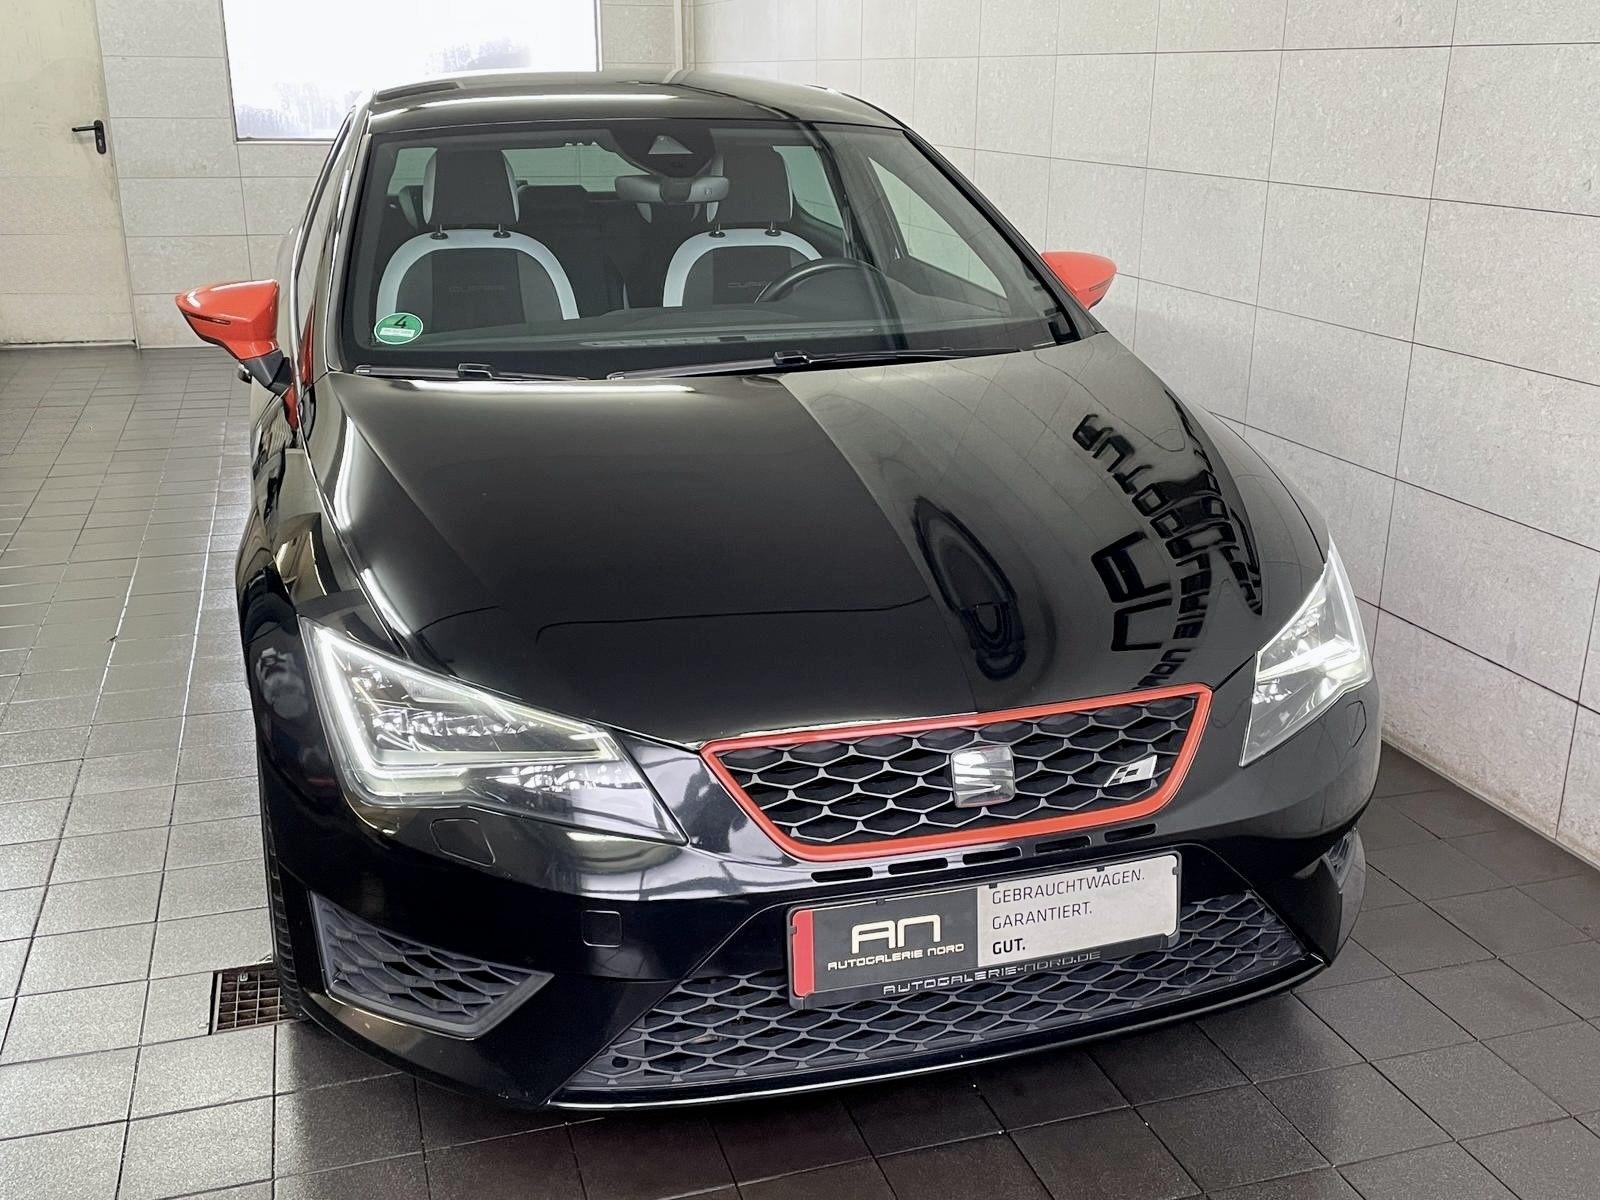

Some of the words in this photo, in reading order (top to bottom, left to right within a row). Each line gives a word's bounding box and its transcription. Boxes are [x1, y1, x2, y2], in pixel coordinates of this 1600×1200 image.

[394, 315, 407, 328] 4
[992, 869, 1145, 904] GEBRAUCHTWAGEN.
[992, 901, 1092, 930] GARANTIERT.
[827, 949, 923, 971] AUTOGALERIE
[927, 943, 965, 957] NORD
[992, 938, 1026, 955] GUT.
[883, 951, 1101, 995] AUTOGALERIE-NORD.DE
